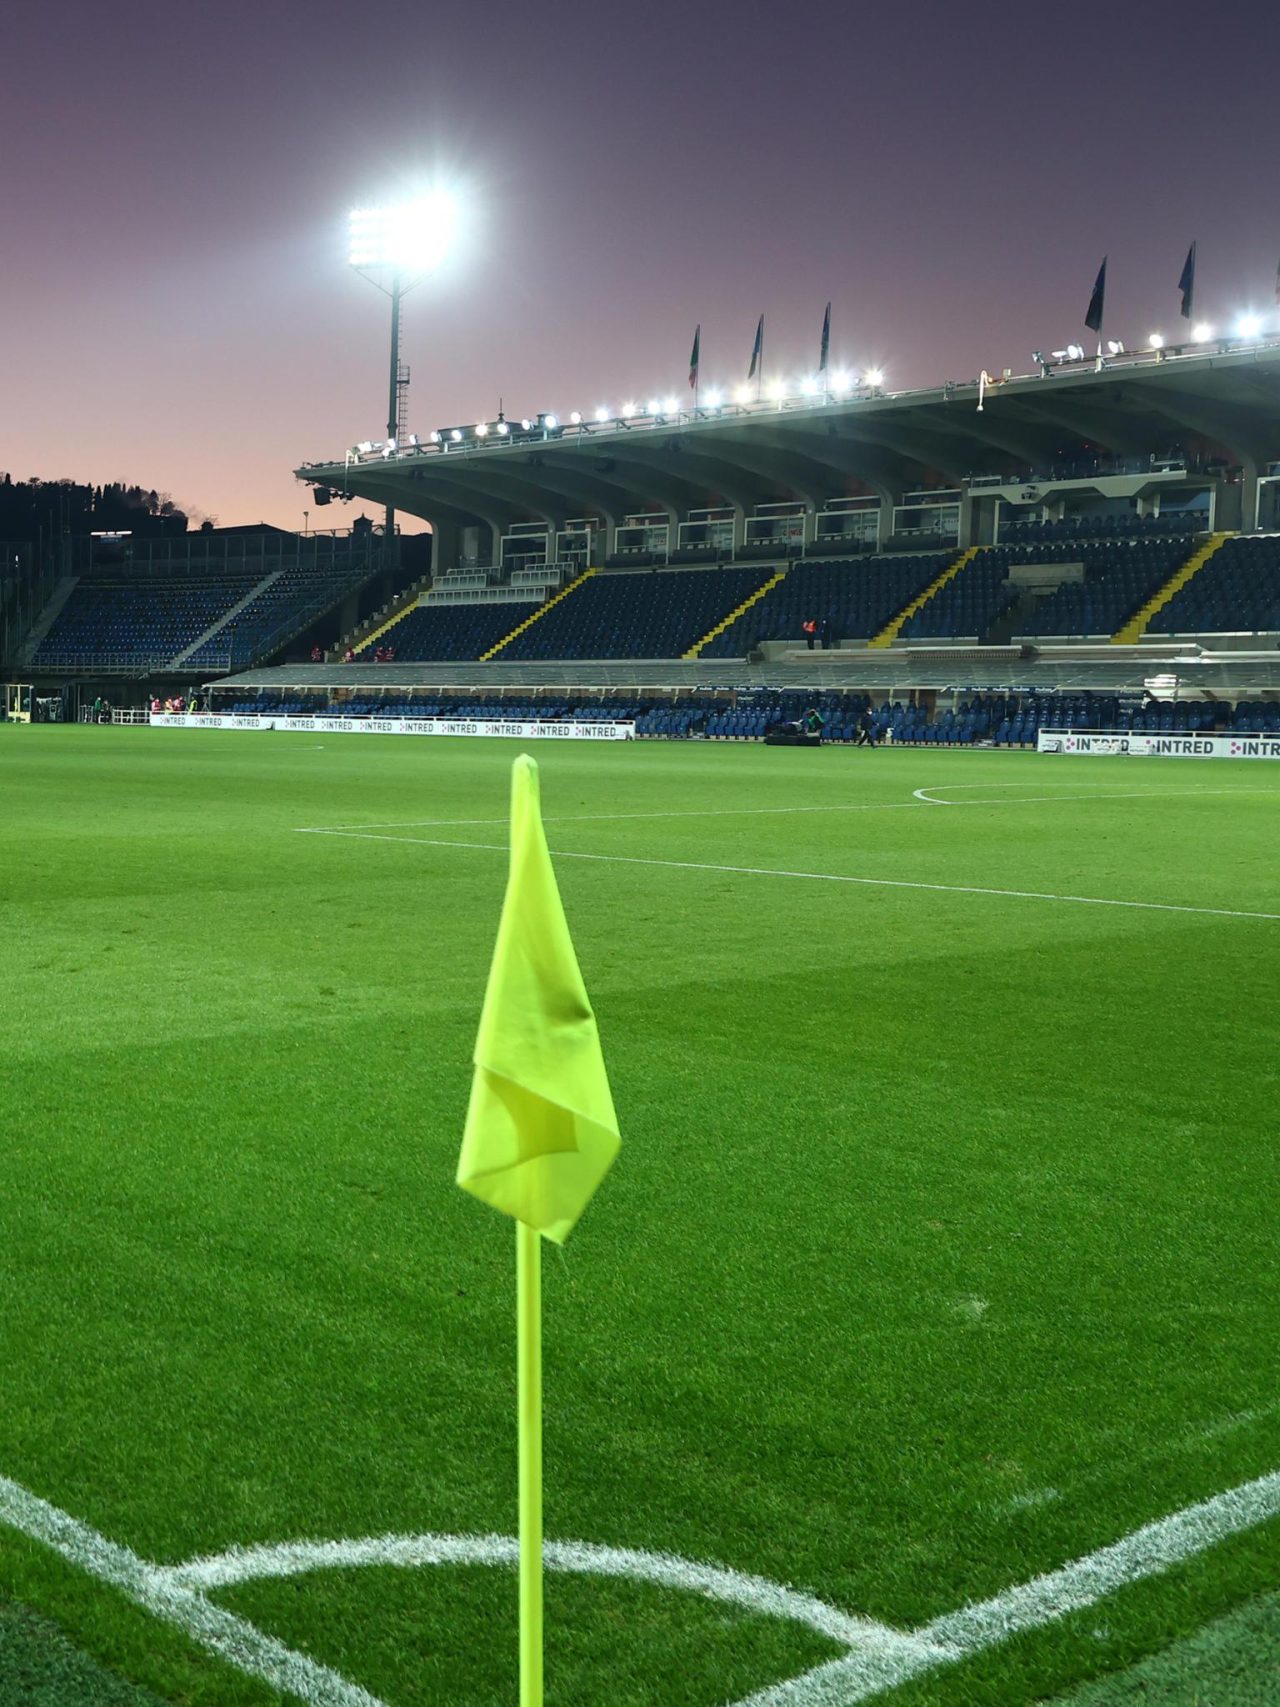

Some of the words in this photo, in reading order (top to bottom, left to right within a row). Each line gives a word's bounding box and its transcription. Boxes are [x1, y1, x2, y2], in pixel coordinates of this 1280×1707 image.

[164, 717, 186, 725] INTRED
[200, 717, 222, 727] INTRED
[236, 718, 260, 727] INTRED
[289, 720, 315, 729] INTRED
[326, 721, 353, 730] INTRED
[365, 722, 392, 731] INTRED
[405, 723, 434, 732] INTRED
[447, 724, 477, 733] INTRED
[491, 725, 523, 735] INTRED
[536, 726, 570, 736] INTRED
[582, 727, 617, 737] INTRED
[1156, 740, 1214, 754] INTRED
